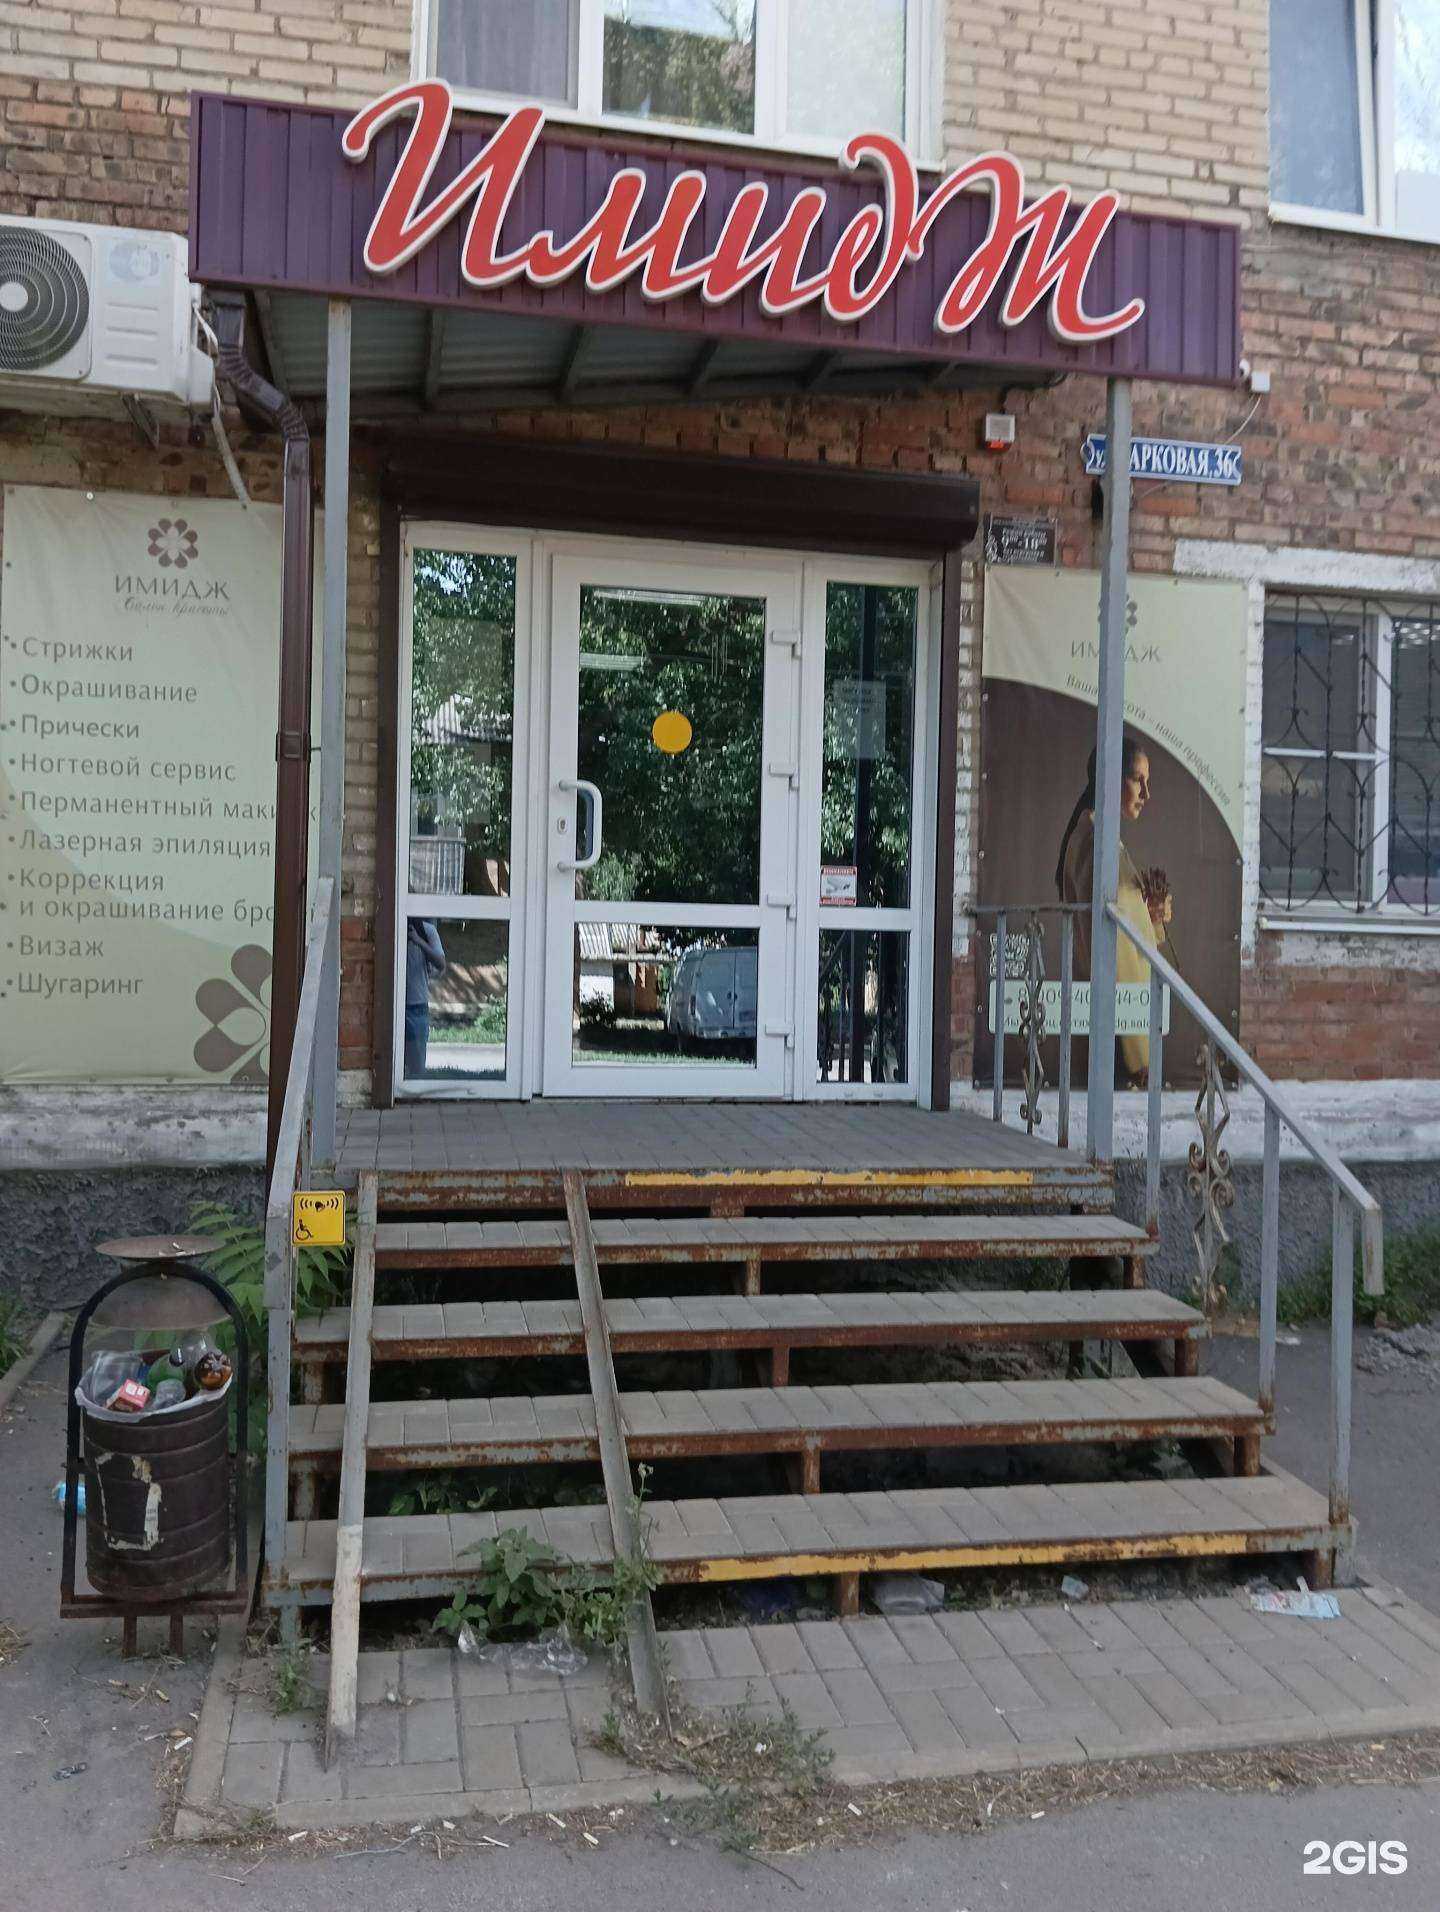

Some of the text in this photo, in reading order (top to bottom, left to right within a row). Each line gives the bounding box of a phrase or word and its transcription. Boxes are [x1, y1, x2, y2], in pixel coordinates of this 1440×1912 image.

[342, 79, 1145, 343] Имидж
[115, 574, 230, 601] ИМИДЖ
[23, 637, 133, 662] Стрижки
[1072, 640, 1162, 662] ИМДЖ
[21, 674, 197, 702] Окрашивание
[21, 714, 140, 739] Прически
[21, 753, 236, 784] Ногтевой сервис
[21, 791, 317, 821] Перманентный мак
[20, 829, 271, 860] Лазерная эпиляция
[20, 869, 164, 893] Коррекция
[20, 899, 316, 927] и окрашивание бро
[20, 935, 104, 958] Визаж
[18, 972, 143, 999] Шугаринг
